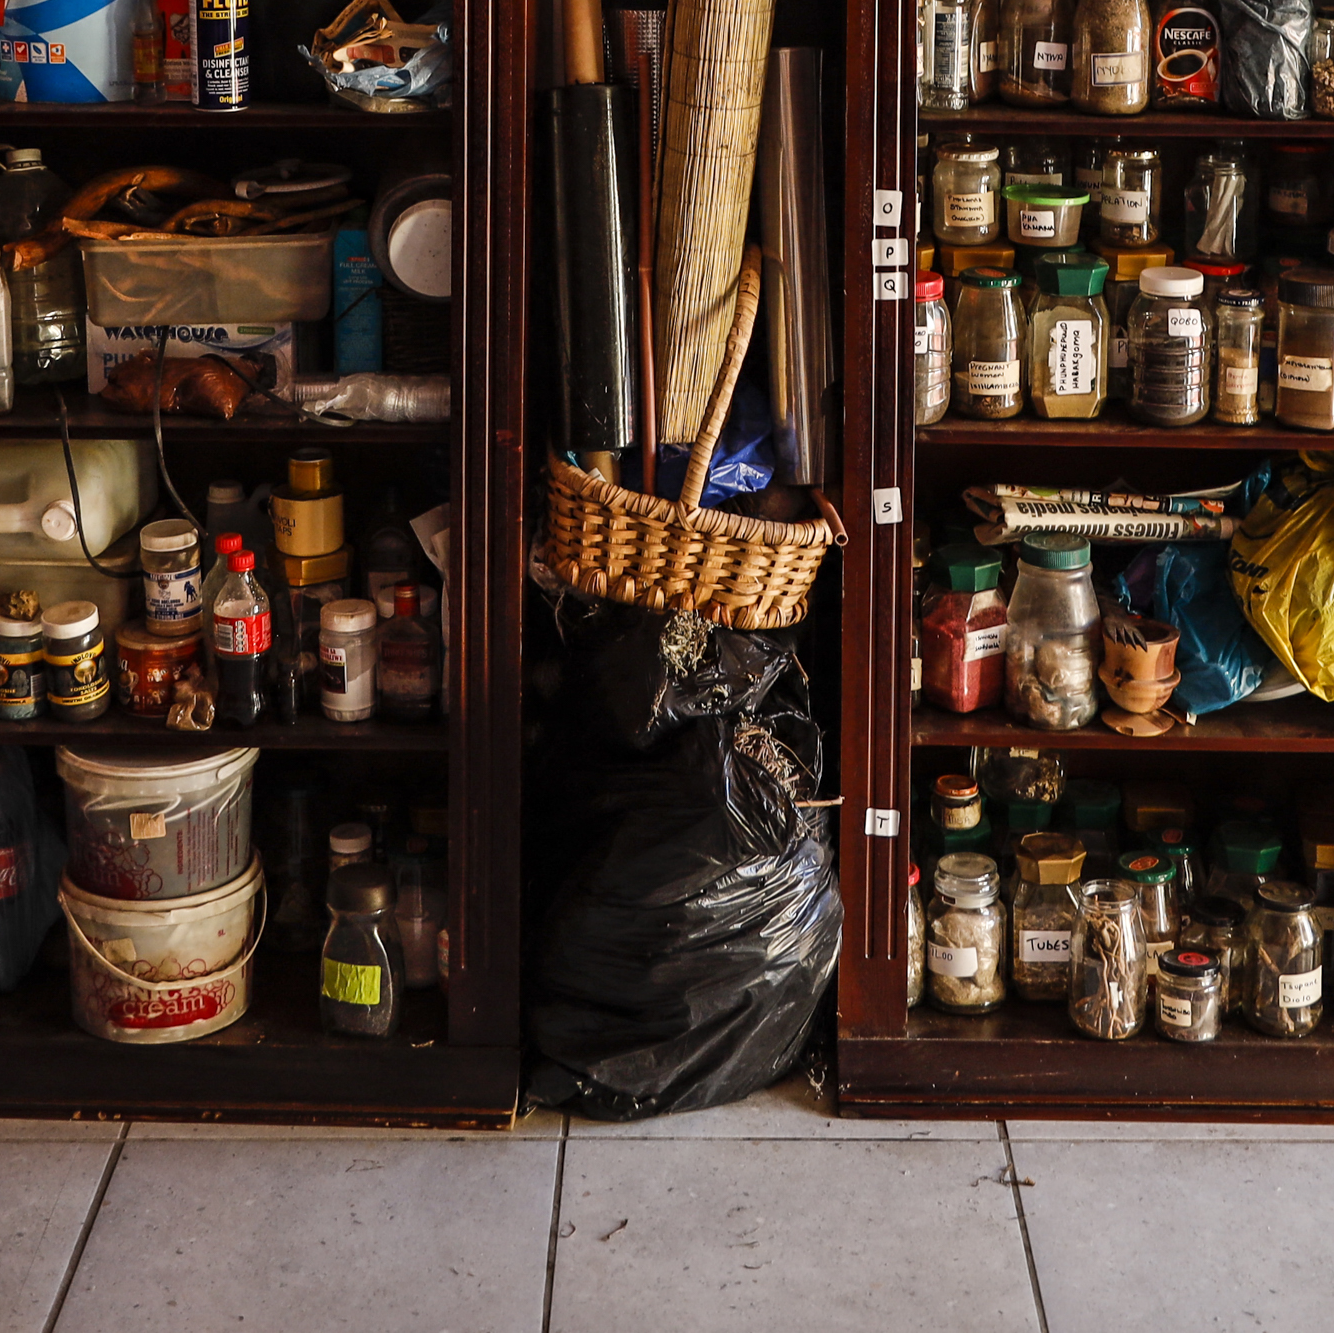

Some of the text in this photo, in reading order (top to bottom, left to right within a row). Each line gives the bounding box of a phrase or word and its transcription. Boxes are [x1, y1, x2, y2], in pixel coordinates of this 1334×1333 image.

[882, 202, 893, 215] O
[886, 245, 894, 260] P
[883, 278, 897, 294] Q
[881, 501, 892, 514] S
[876, 814, 890, 830] T
